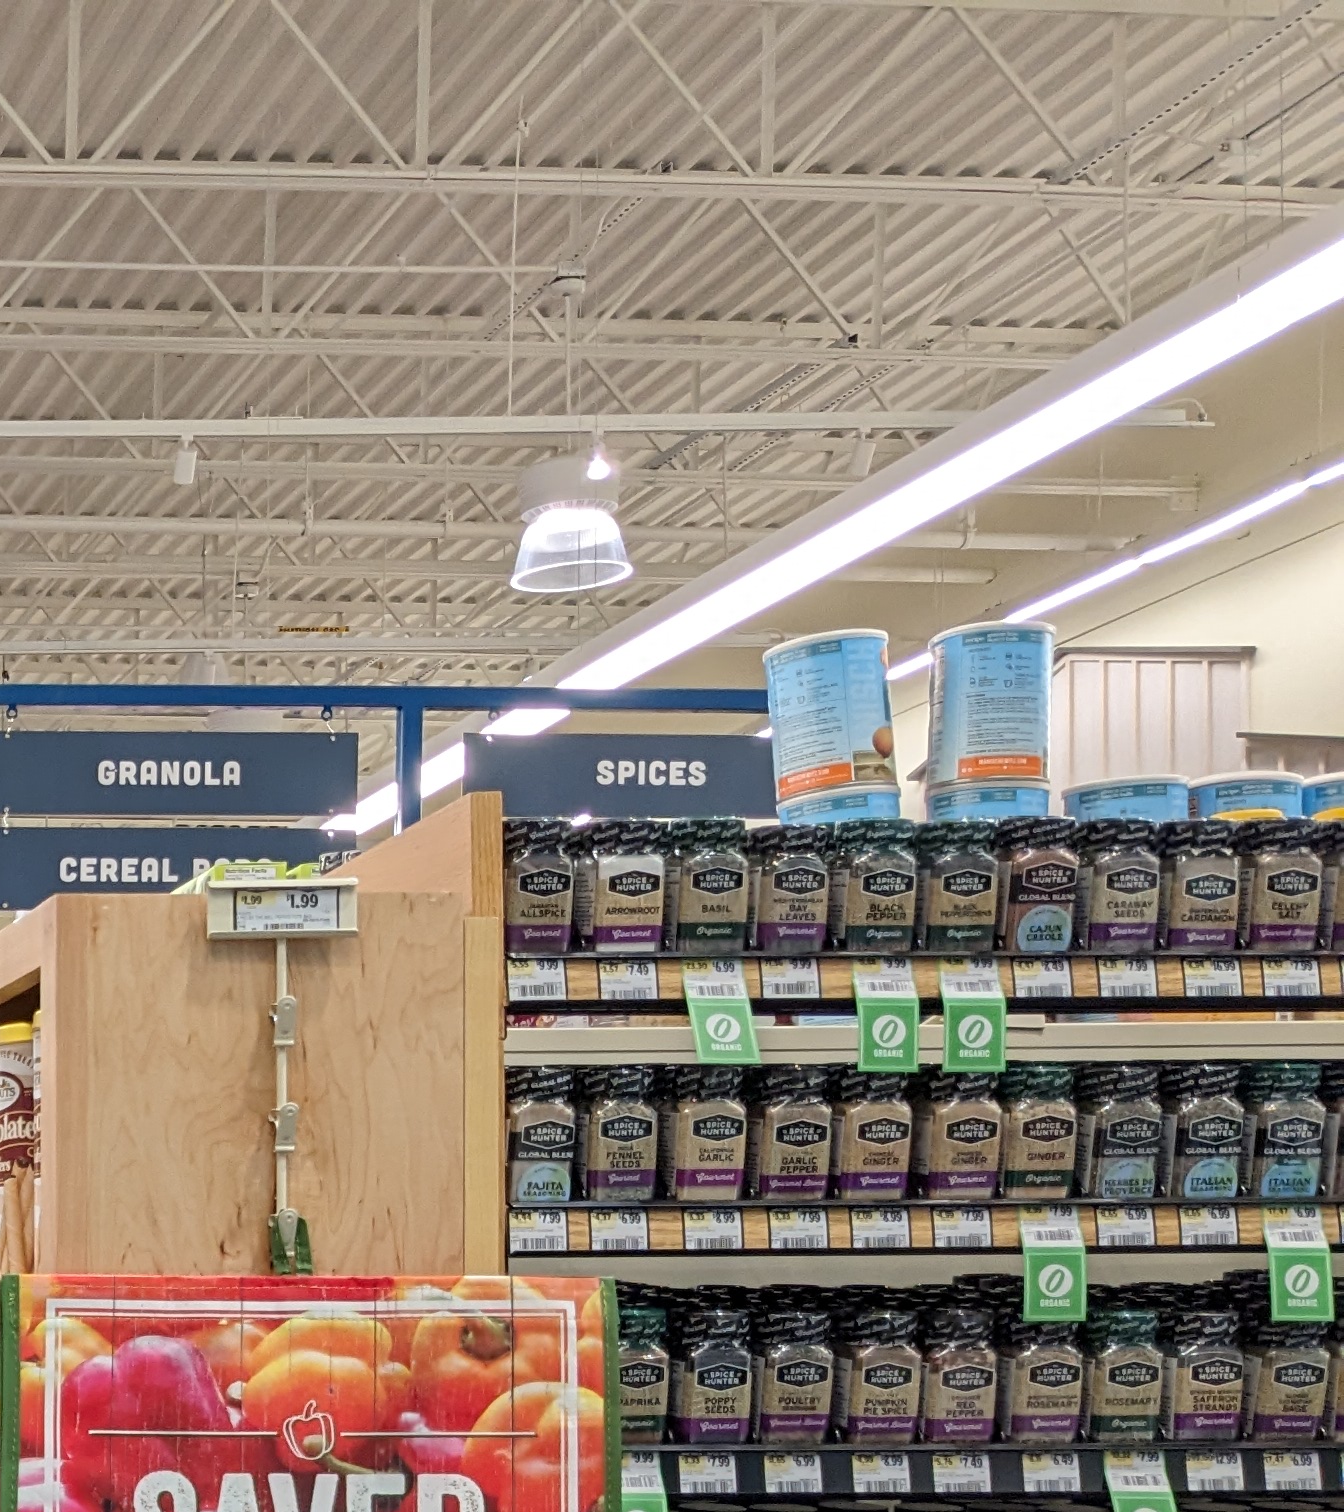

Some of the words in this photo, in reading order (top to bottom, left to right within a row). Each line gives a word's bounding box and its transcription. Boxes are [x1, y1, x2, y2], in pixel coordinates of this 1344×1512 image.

[98, 760, 241, 786] GRANOLA
[596, 759, 707, 788] SPICES
[60, 857, 179, 883] CEREAL
[286, 892, 319, 910] $1.99
[520, 907, 566, 918] ALLSPICE
[605, 906, 660, 916] ARROWROOT
[701, 904, 732, 914] BASIL
[869, 903, 904, 912] BLACK
[865, 911, 907, 922] PEPPER
[1029, 924, 1062, 933] CAJUN
[873, 1049, 904, 1058] ORGANIC
[606, 1151, 645, 1160] FENNEL
[699, 1153, 735, 1163] GARLIC
[526, 1181, 564, 1191] FAJITA
